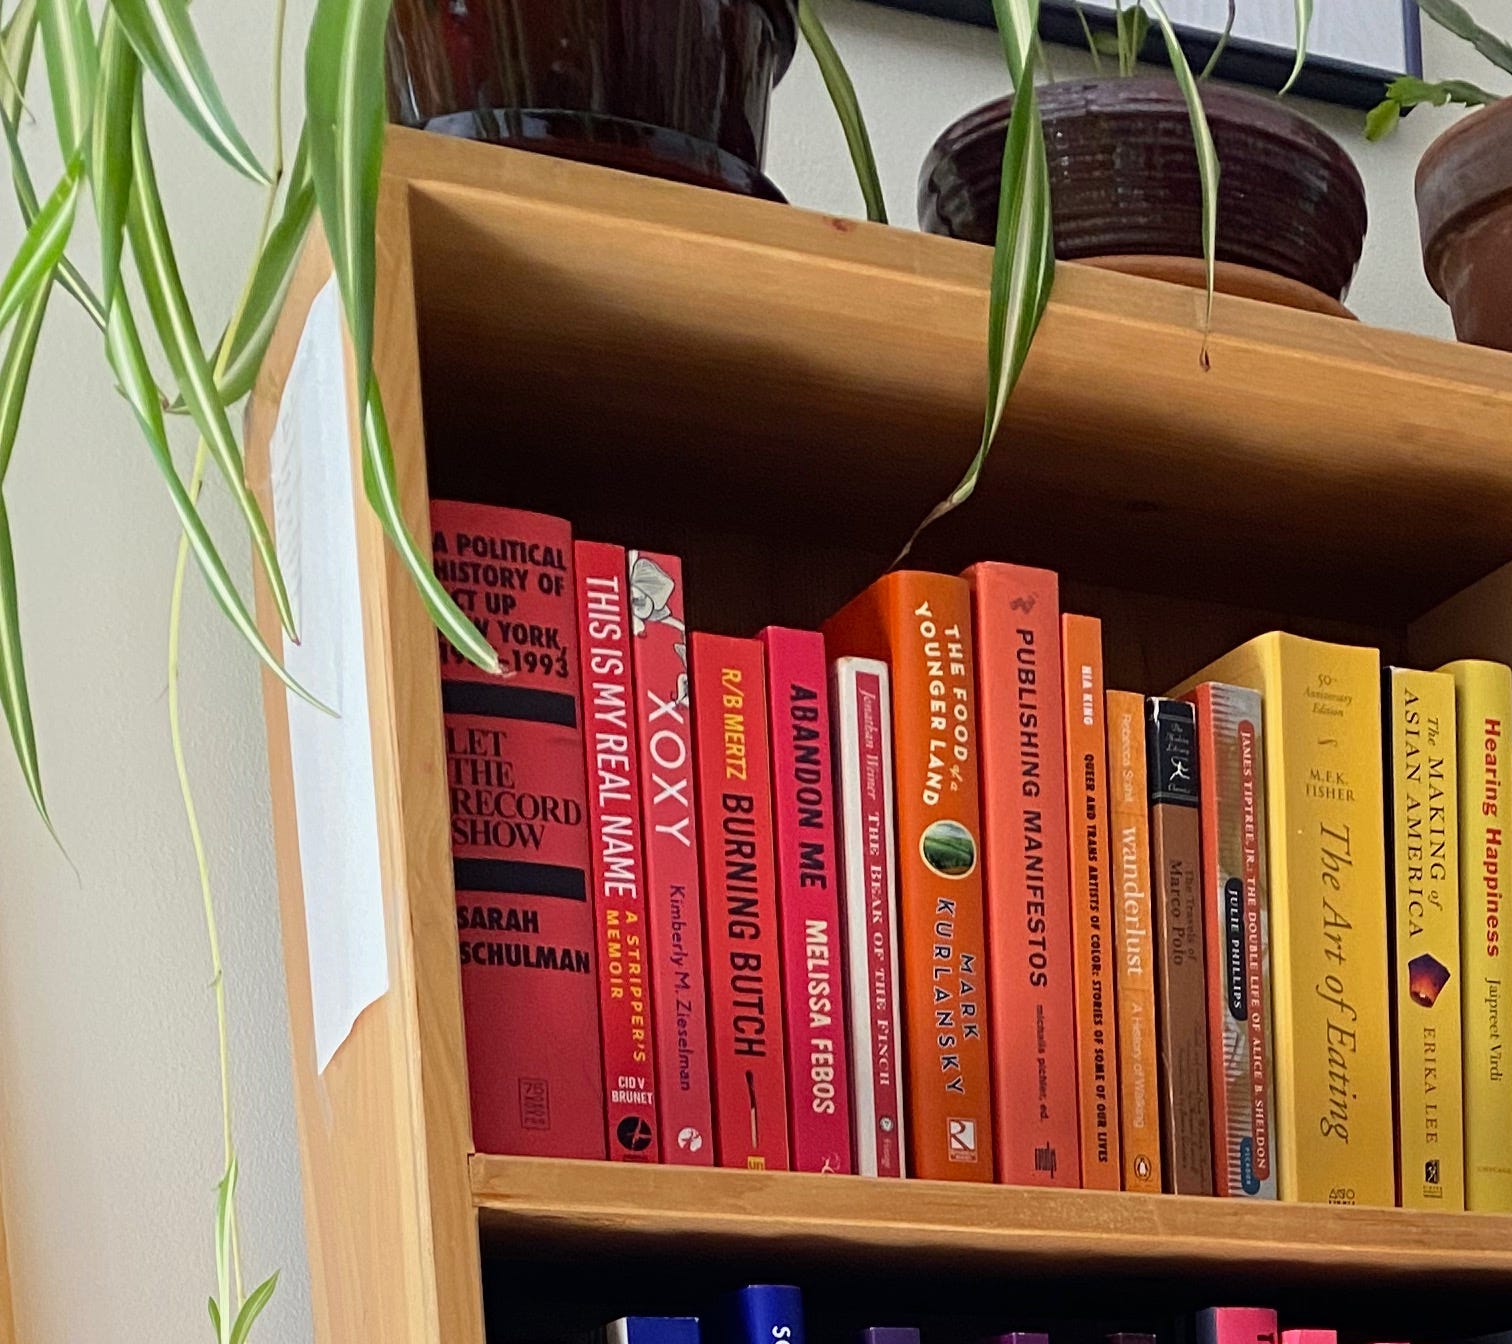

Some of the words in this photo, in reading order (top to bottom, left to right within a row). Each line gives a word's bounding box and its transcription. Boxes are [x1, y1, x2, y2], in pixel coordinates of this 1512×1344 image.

[586, 575, 619, 640] THIS
[590, 647, 622, 675] IS
[914, 601, 945, 735] YOUNGER
[944, 624, 964, 680] THE
[590, 683, 626, 725] MY
[720, 668, 743, 708] R/B
[949, 687, 968, 759] FOOD
[1016, 629, 1041, 798] PUBLISHING
[446, 728, 506, 757] LET
[596, 734, 630, 805] REAL
[647, 691, 690, 847] XOXY
[723, 714, 747, 779] MERTZ
[790, 683, 823, 829] ABANDON
[1403, 688, 1421, 783] ASIAN
[1483, 718, 1502, 816] Hearing
[453, 790, 581, 825] RECORD
[454, 758, 515, 789] THE
[922, 740, 946, 806] LAND
[453, 820, 546, 850] SHOW
[599, 815, 636, 898] NAME
[722, 793, 761, 940] BURNING
[797, 842, 827, 889] ME
[1319, 821, 1351, 888] The
[1406, 795, 1424, 939] AMERICA
[458, 906, 540, 933] SARAH
[624, 910, 639, 922] A
[668, 885, 688, 967] Kimberly
[1023, 810, 1048, 987] MANIFESTOS
[1121, 826, 1147, 977] wanderlust
[1229, 889, 1241, 931] JULIE
[1484, 827, 1503, 957] Happiness
[460, 942, 591, 973] SCHULMAN
[605, 910, 624, 998] MEMOIR
[1322, 898, 1355, 963] Art
[626, 934, 646, 1061] STRIPPER'S
[673, 971, 690, 993] M.
[731, 952, 765, 1057] BUTCH
[805, 920, 831, 1029] MELISSA
[1229, 939, 1244, 1009] PHILLIPS
[1321, 973, 1357, 1021] of
[811, 1038, 835, 1114] FEBOS
[1320, 1023, 1357, 1144] Eating
